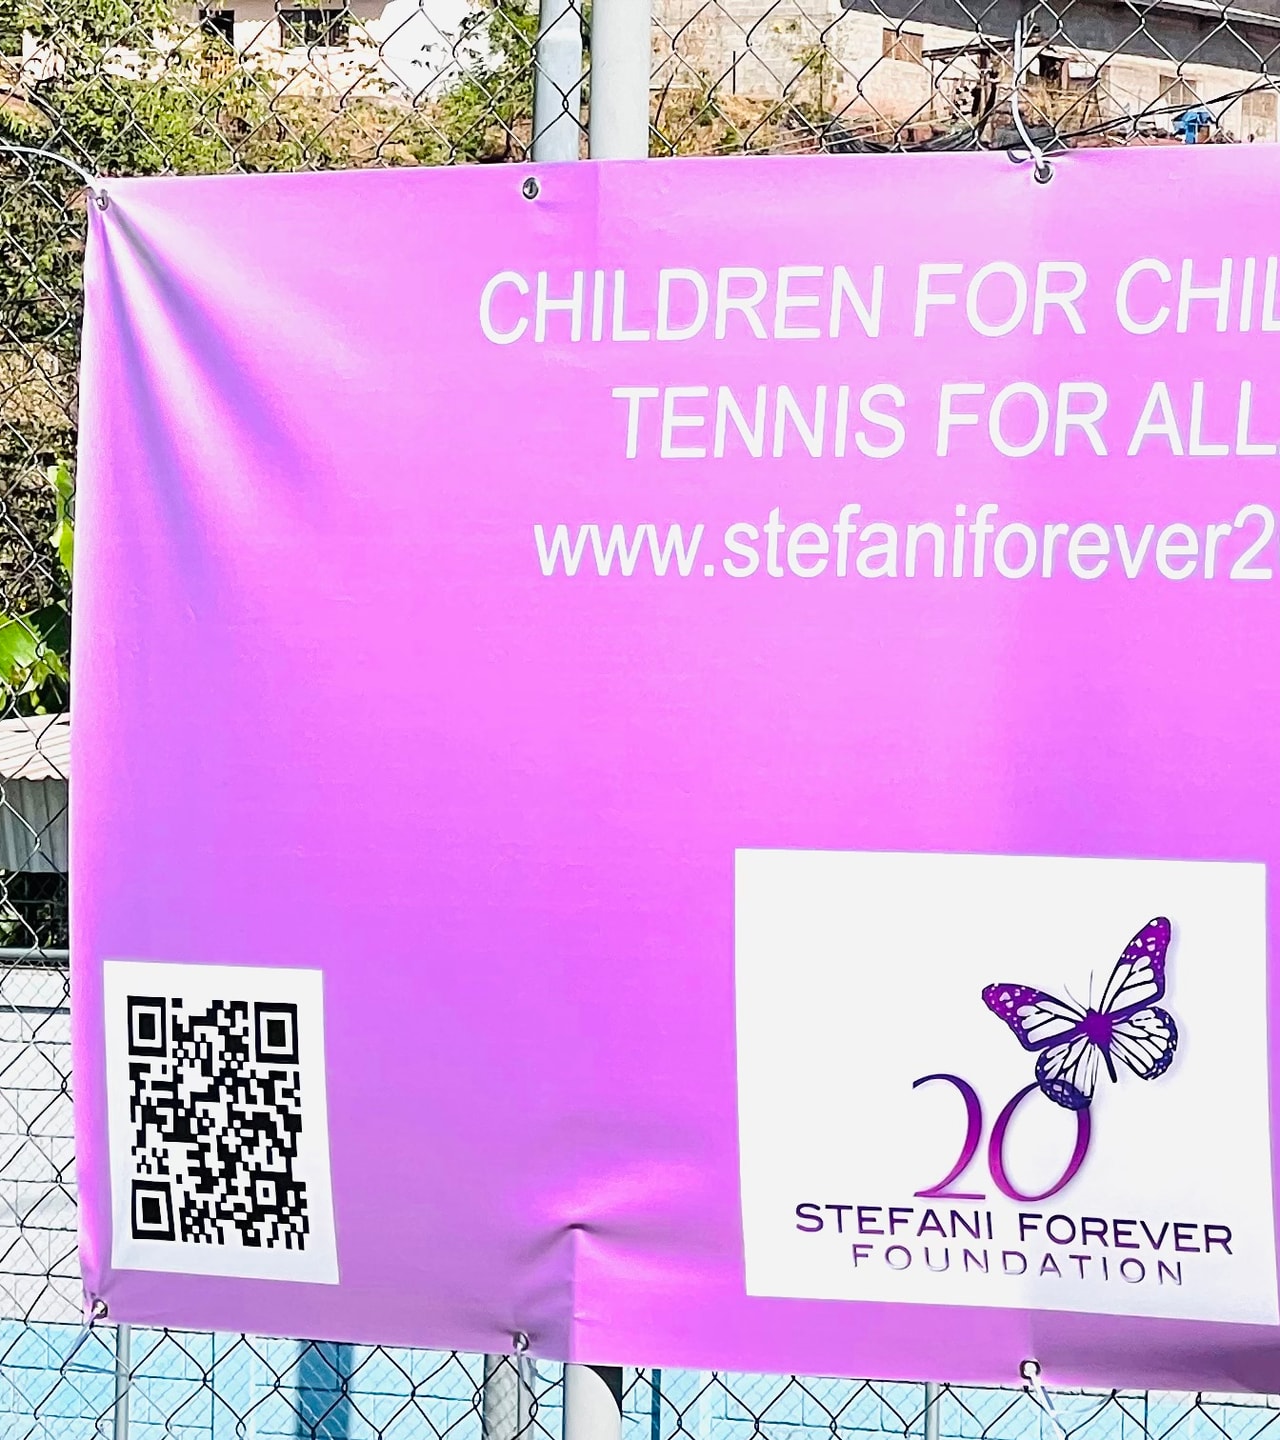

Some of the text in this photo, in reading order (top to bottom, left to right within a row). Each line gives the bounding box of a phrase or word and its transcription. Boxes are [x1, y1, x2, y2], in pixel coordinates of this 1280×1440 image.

[479, 265, 886, 345] CHILDREN
[913, 259, 1089, 338] FOR
[611, 383, 907, 460] TENNIS
[936, 380, 1108, 459] FOR
[912, 1073, 1092, 1202] 20
[795, 1202, 1234, 1256] STEFANI FOREVER
[851, 1243, 1183, 1287] FOUNDATION
